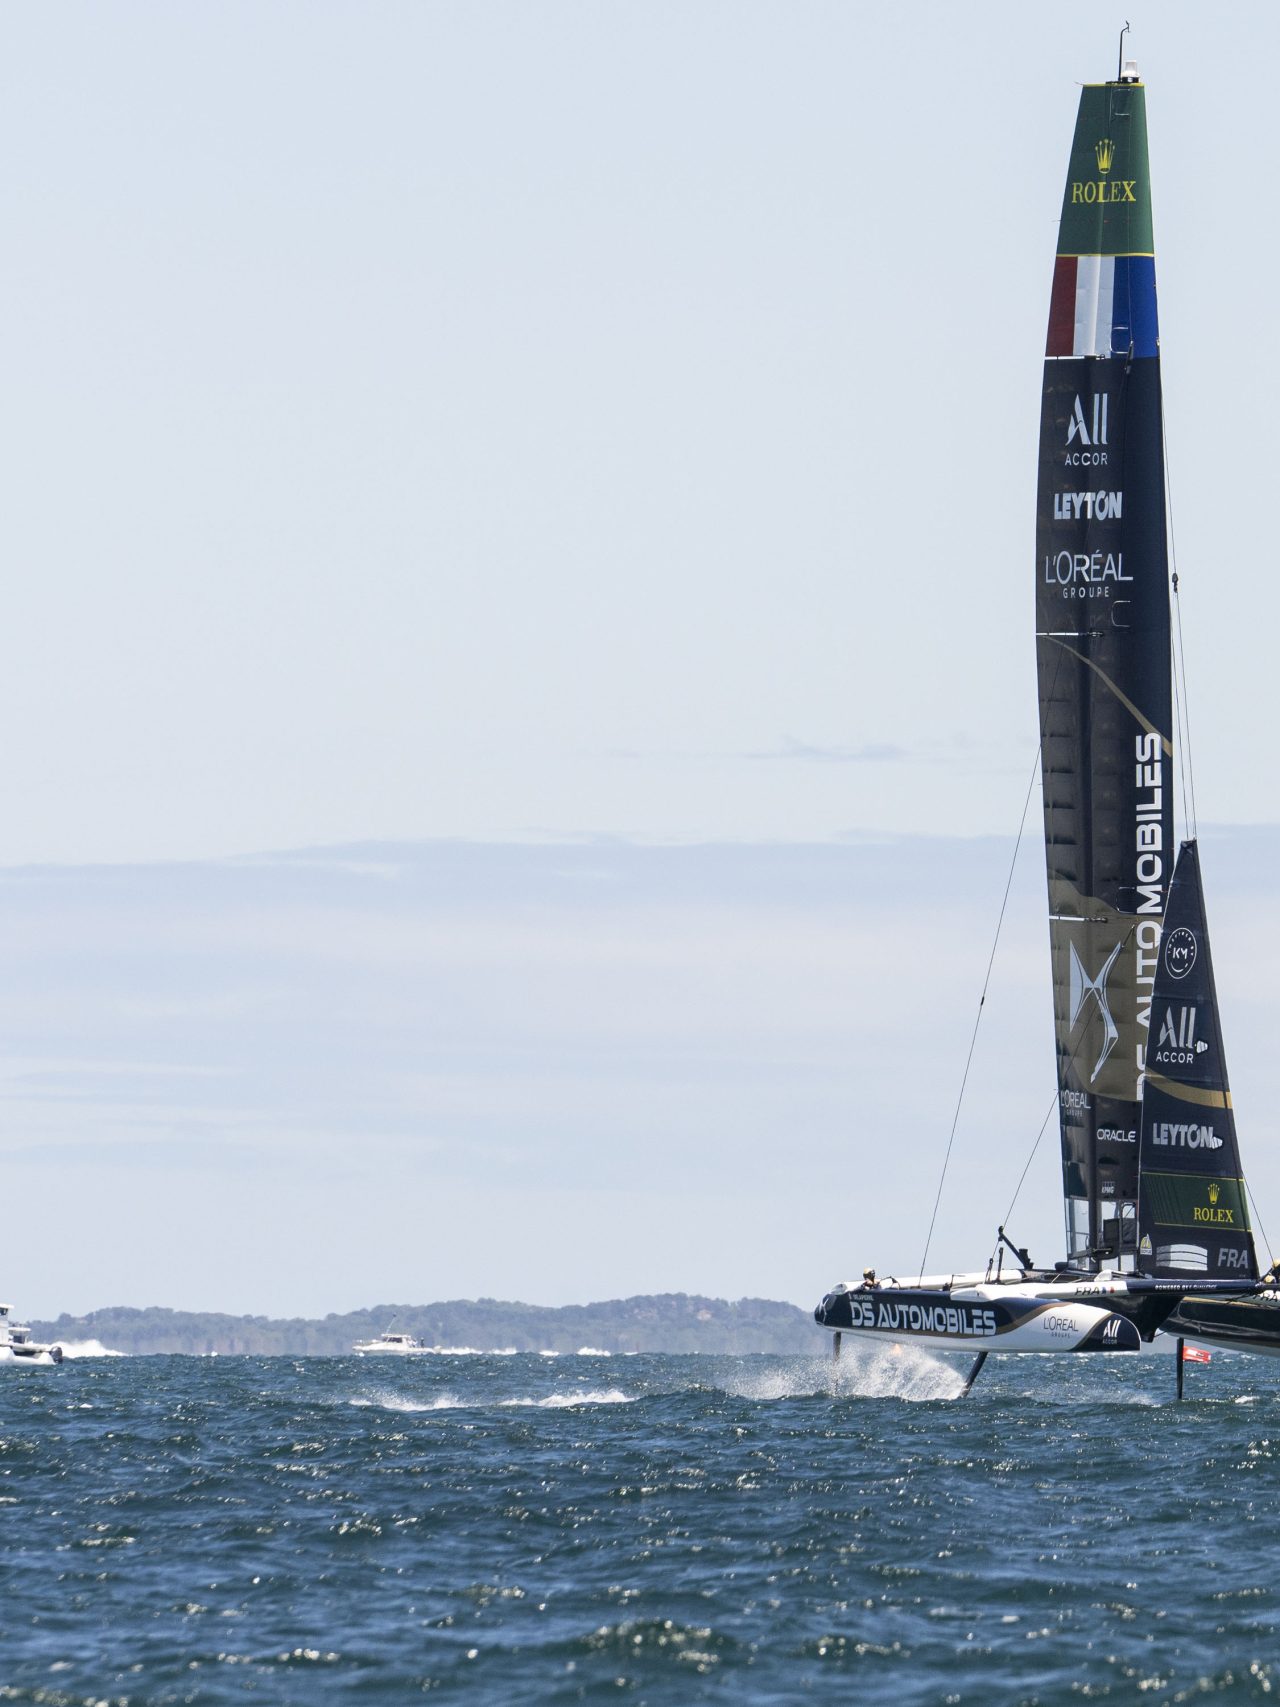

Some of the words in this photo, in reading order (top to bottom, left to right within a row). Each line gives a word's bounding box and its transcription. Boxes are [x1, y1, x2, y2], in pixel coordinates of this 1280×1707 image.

[1071, 181, 1137, 204] ROLEX
[1064, 452, 1108, 466] ACCOR
[1053, 490, 1123, 521] LEYTON
[1045, 549, 1134, 585] L'ORÉAL
[1062, 586, 1110, 599] GROUPE
[1155, 1051, 1194, 1064] ACCOR
[1096, 1128, 1137, 1143] ORACLE
[1153, 1122, 1214, 1150] LEYTON
[1193, 1207, 1234, 1223] ROLEX
[1217, 1247, 1249, 1269] FRA
[1074, 1286, 1100, 1296] FRA
[849, 1301, 875, 1327] DS
[877, 1303, 997, 1336] AUTOMOBILES
